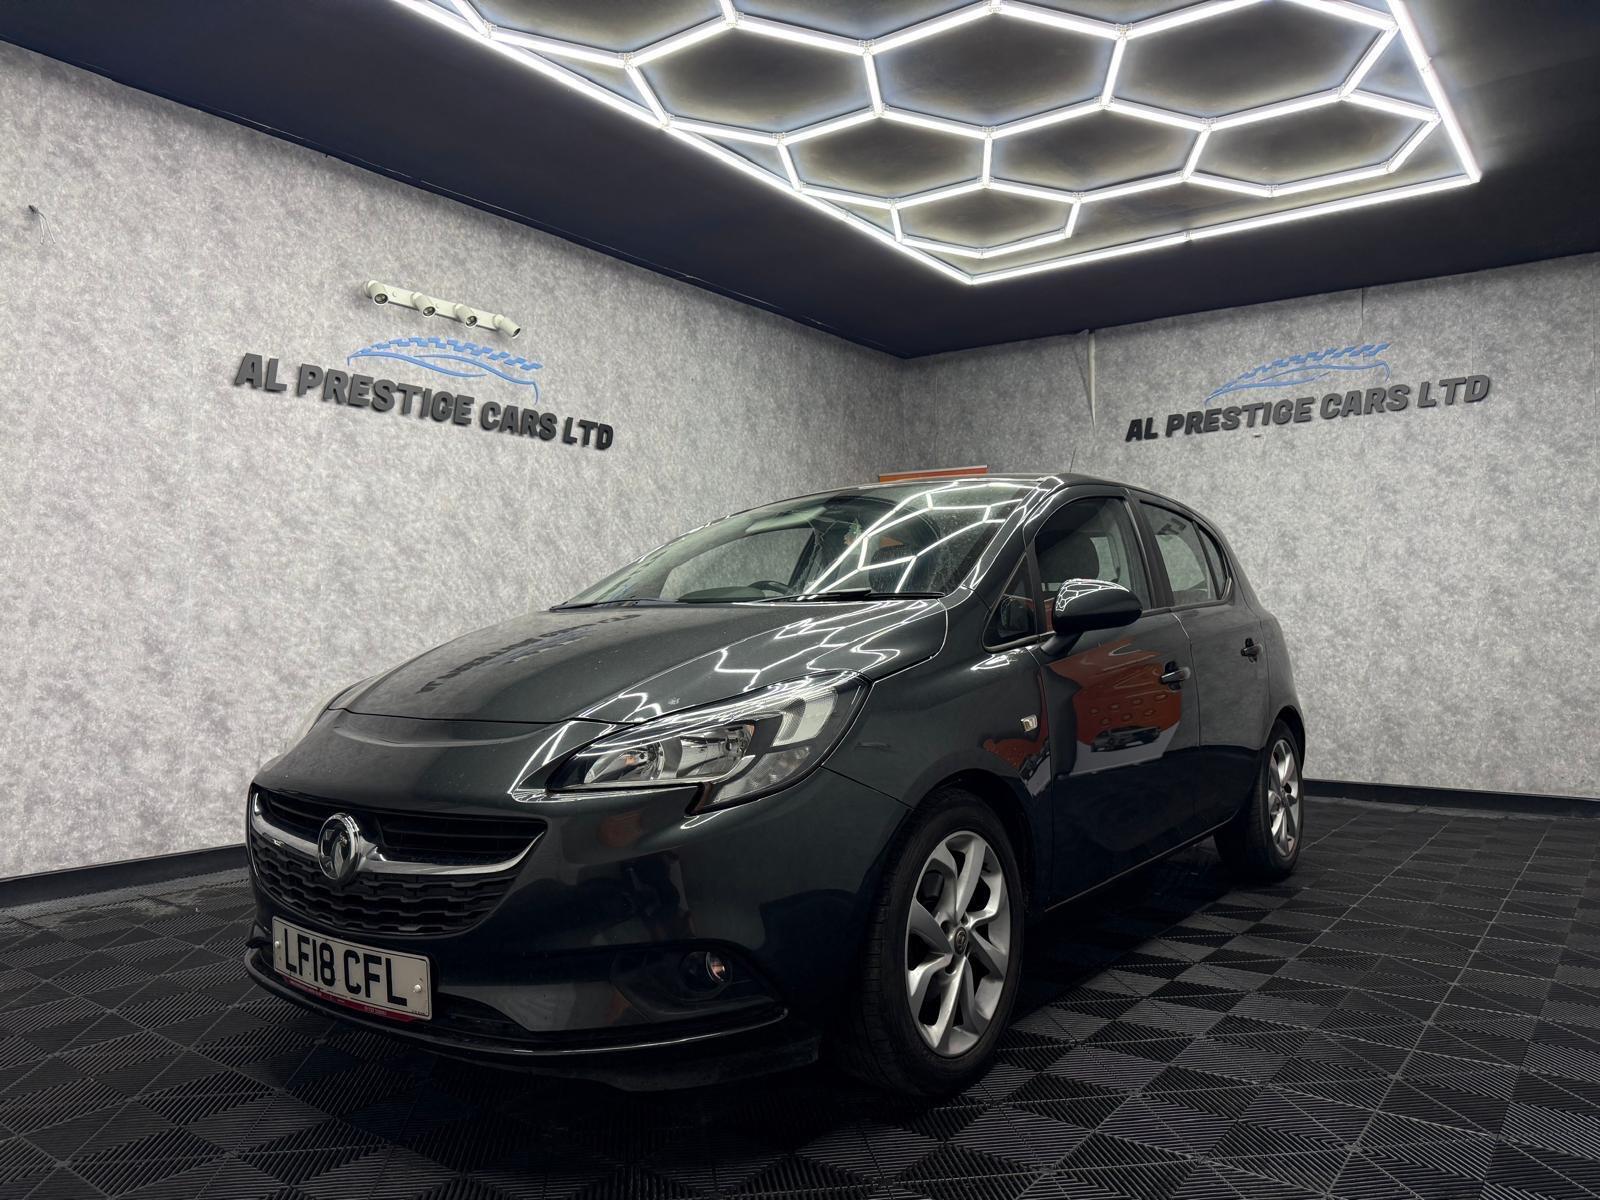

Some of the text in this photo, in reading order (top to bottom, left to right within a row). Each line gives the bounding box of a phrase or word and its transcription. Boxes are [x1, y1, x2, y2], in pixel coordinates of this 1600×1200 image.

[234, 353, 613, 450] AL PRESTIGE CARS LTD
[1125, 375, 1490, 442] AL PRESTIGE CARS LTD
[284, 928, 408, 1007] LF18 CFL
